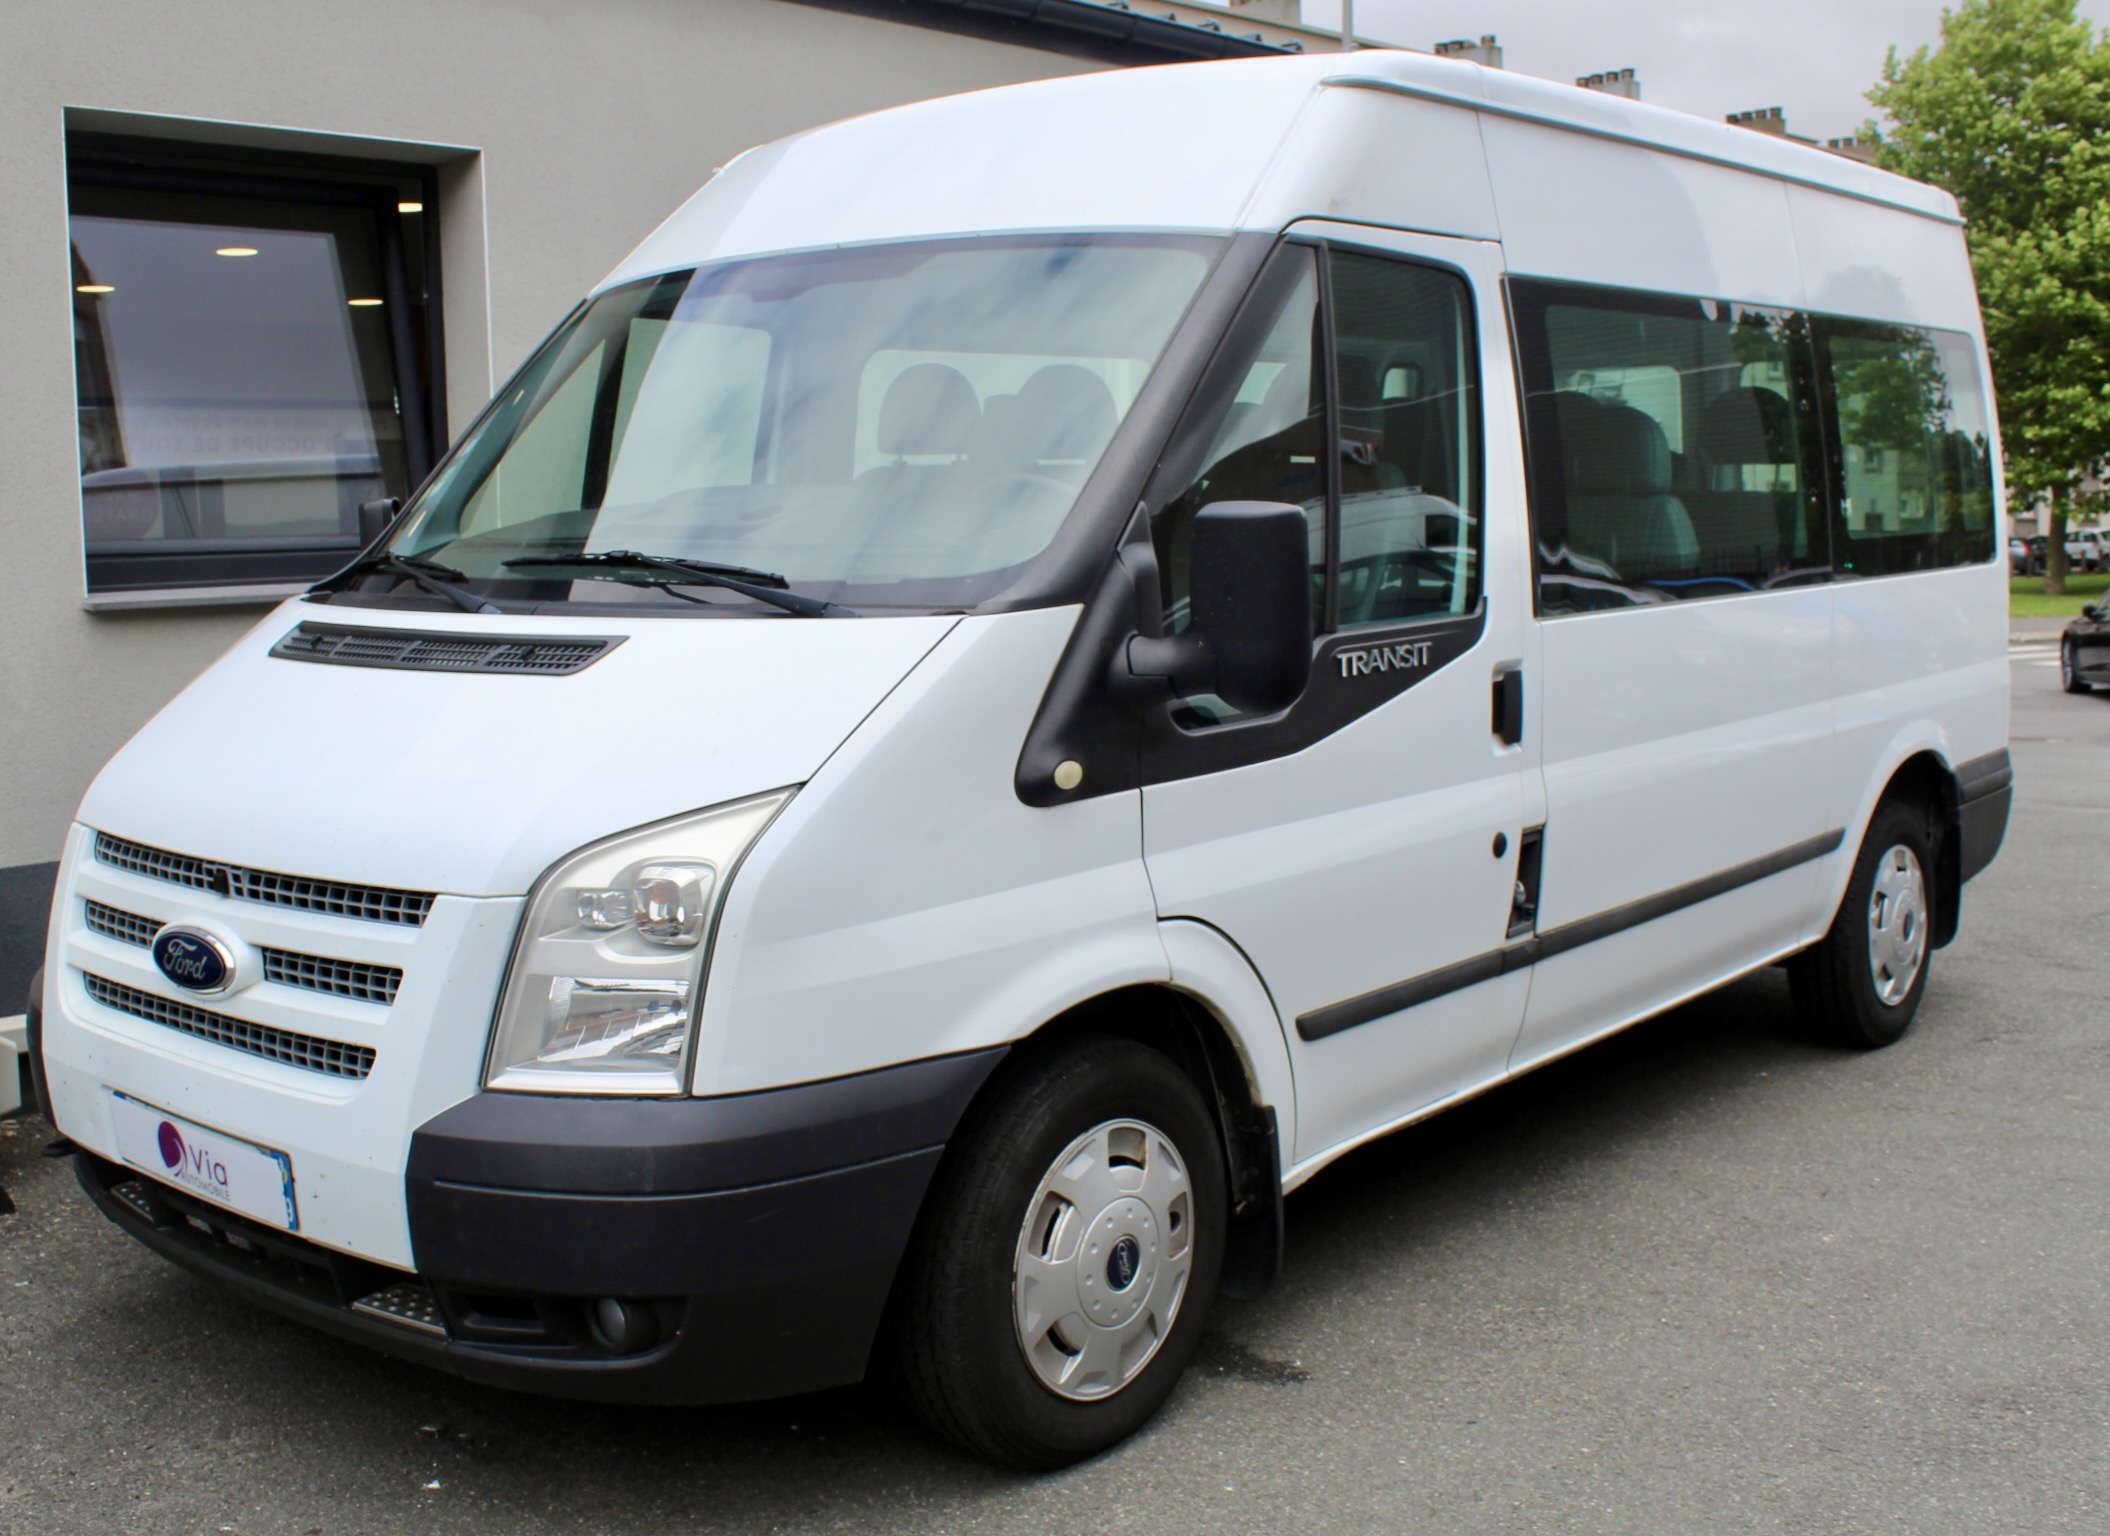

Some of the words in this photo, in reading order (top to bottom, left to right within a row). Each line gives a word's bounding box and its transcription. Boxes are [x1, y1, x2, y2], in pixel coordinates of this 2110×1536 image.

[1335, 641, 1433, 678] TRANSIT
[163, 938, 208, 980] Ford
[188, 1144, 228, 1186] Via
[181, 1171, 231, 1202] AUTOMOBILE
